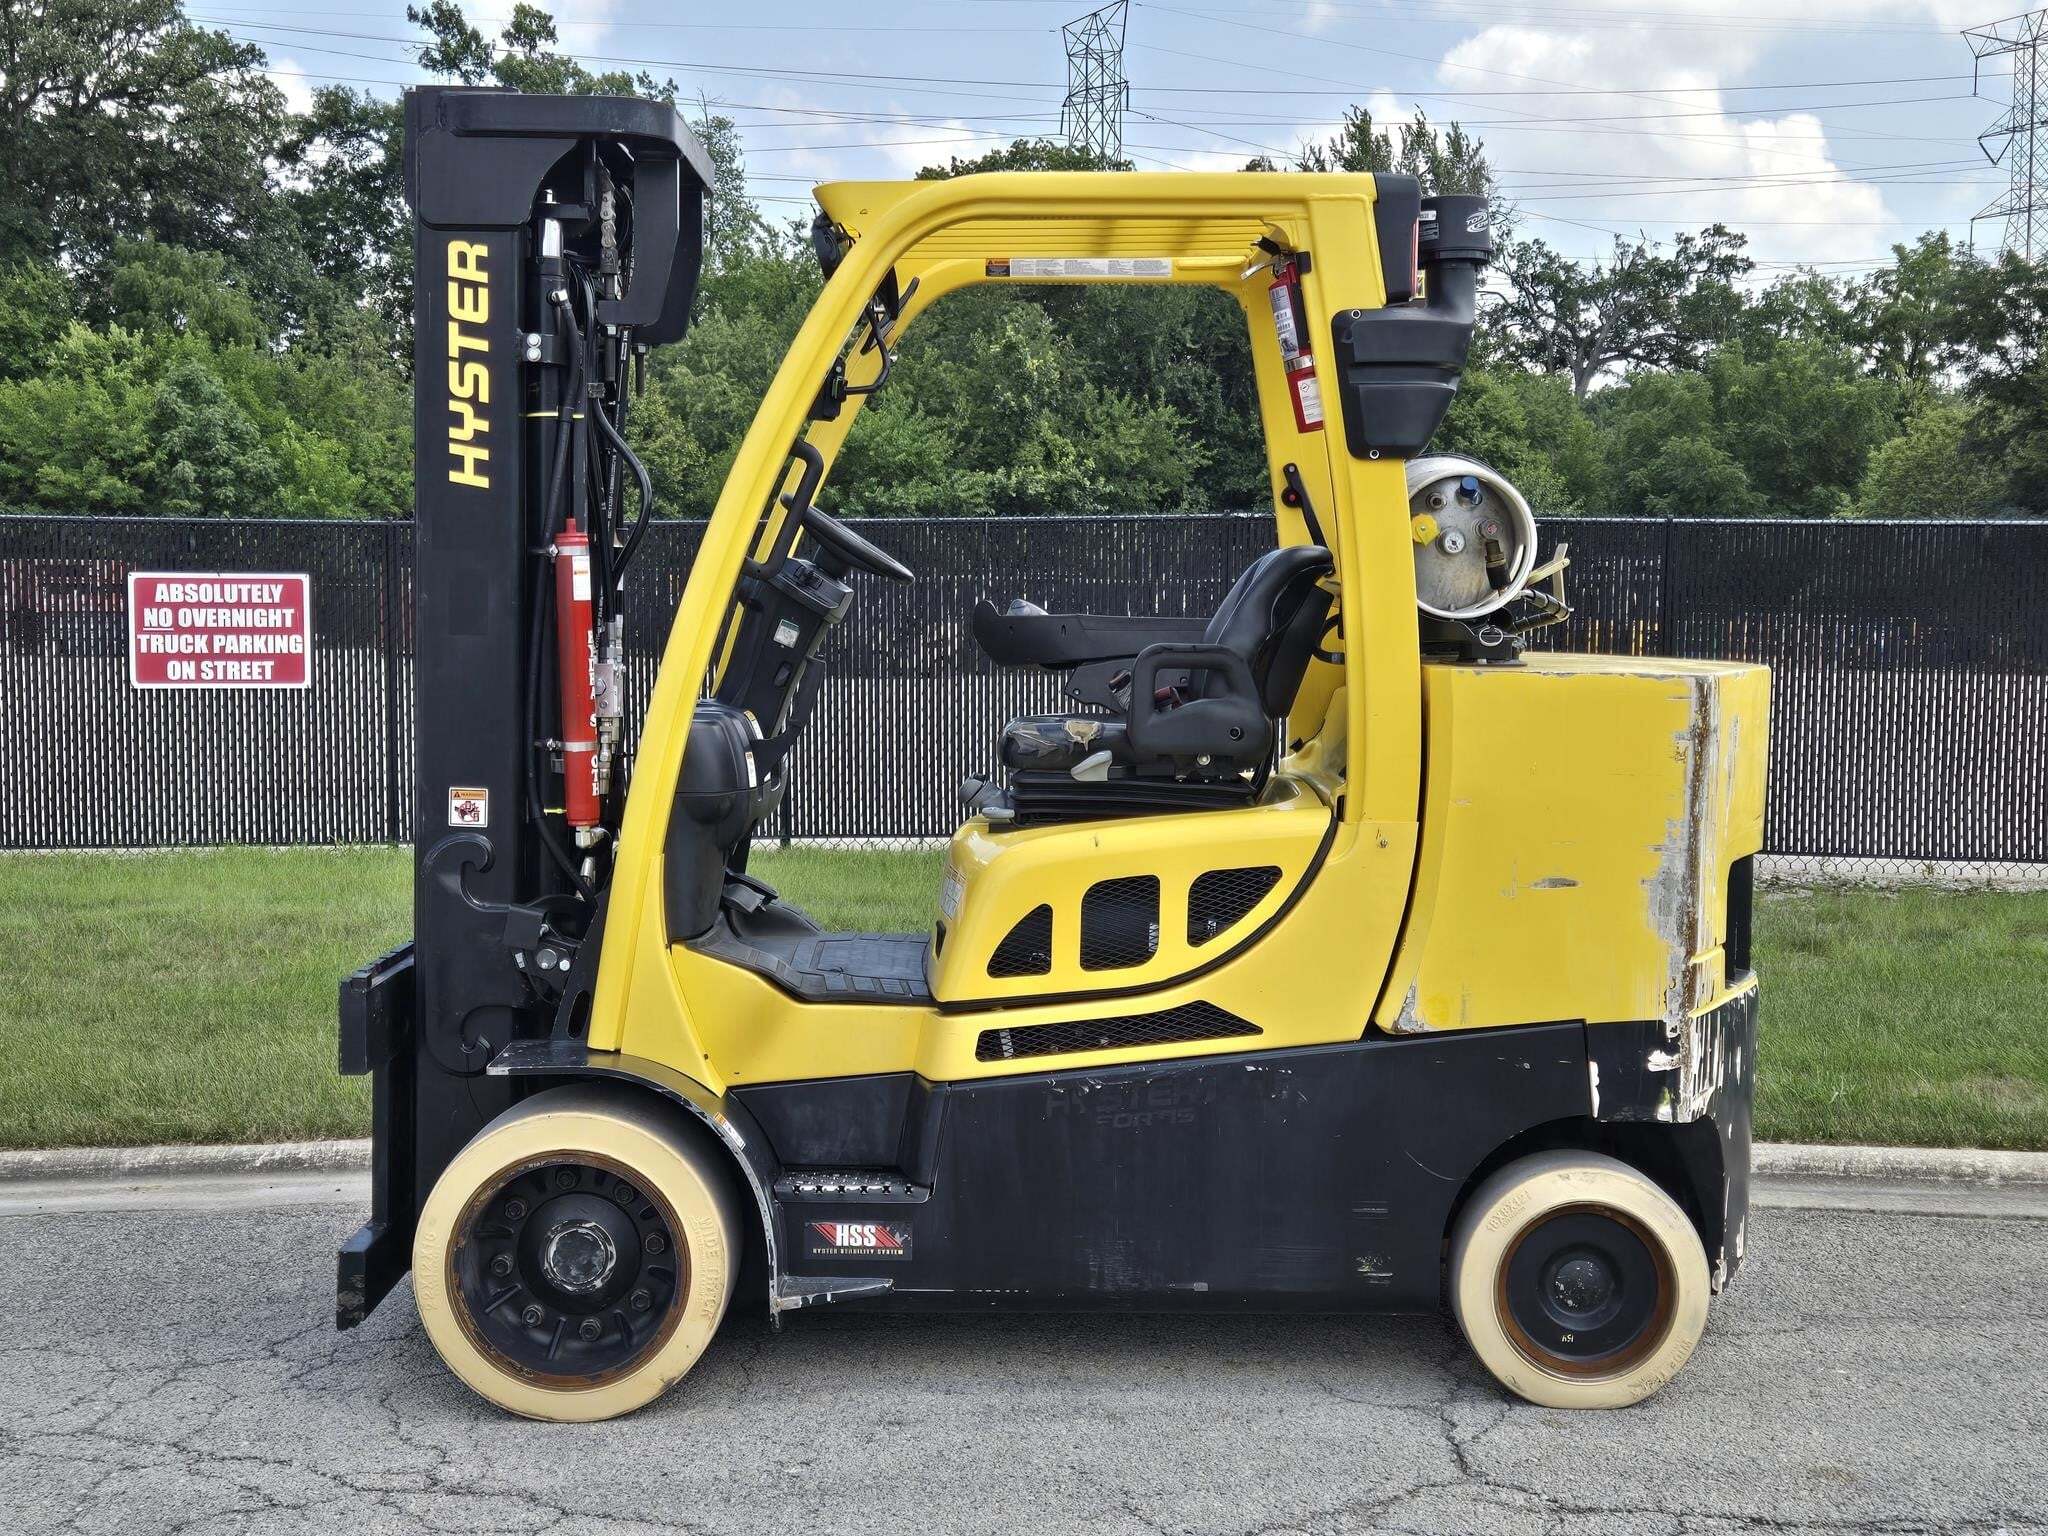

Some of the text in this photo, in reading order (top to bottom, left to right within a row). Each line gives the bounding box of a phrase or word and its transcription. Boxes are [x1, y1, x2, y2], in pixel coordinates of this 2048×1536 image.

[447, 240, 490, 489] HYSTER
[154, 583, 284, 604] ABSOLUTELY
[143, 607, 295, 631] NO OVERNIGHT
[136, 634, 304, 655] TRUCK PARKING
[166, 660, 275, 681] ON STREET
[835, 1224, 876, 1247] HSS
